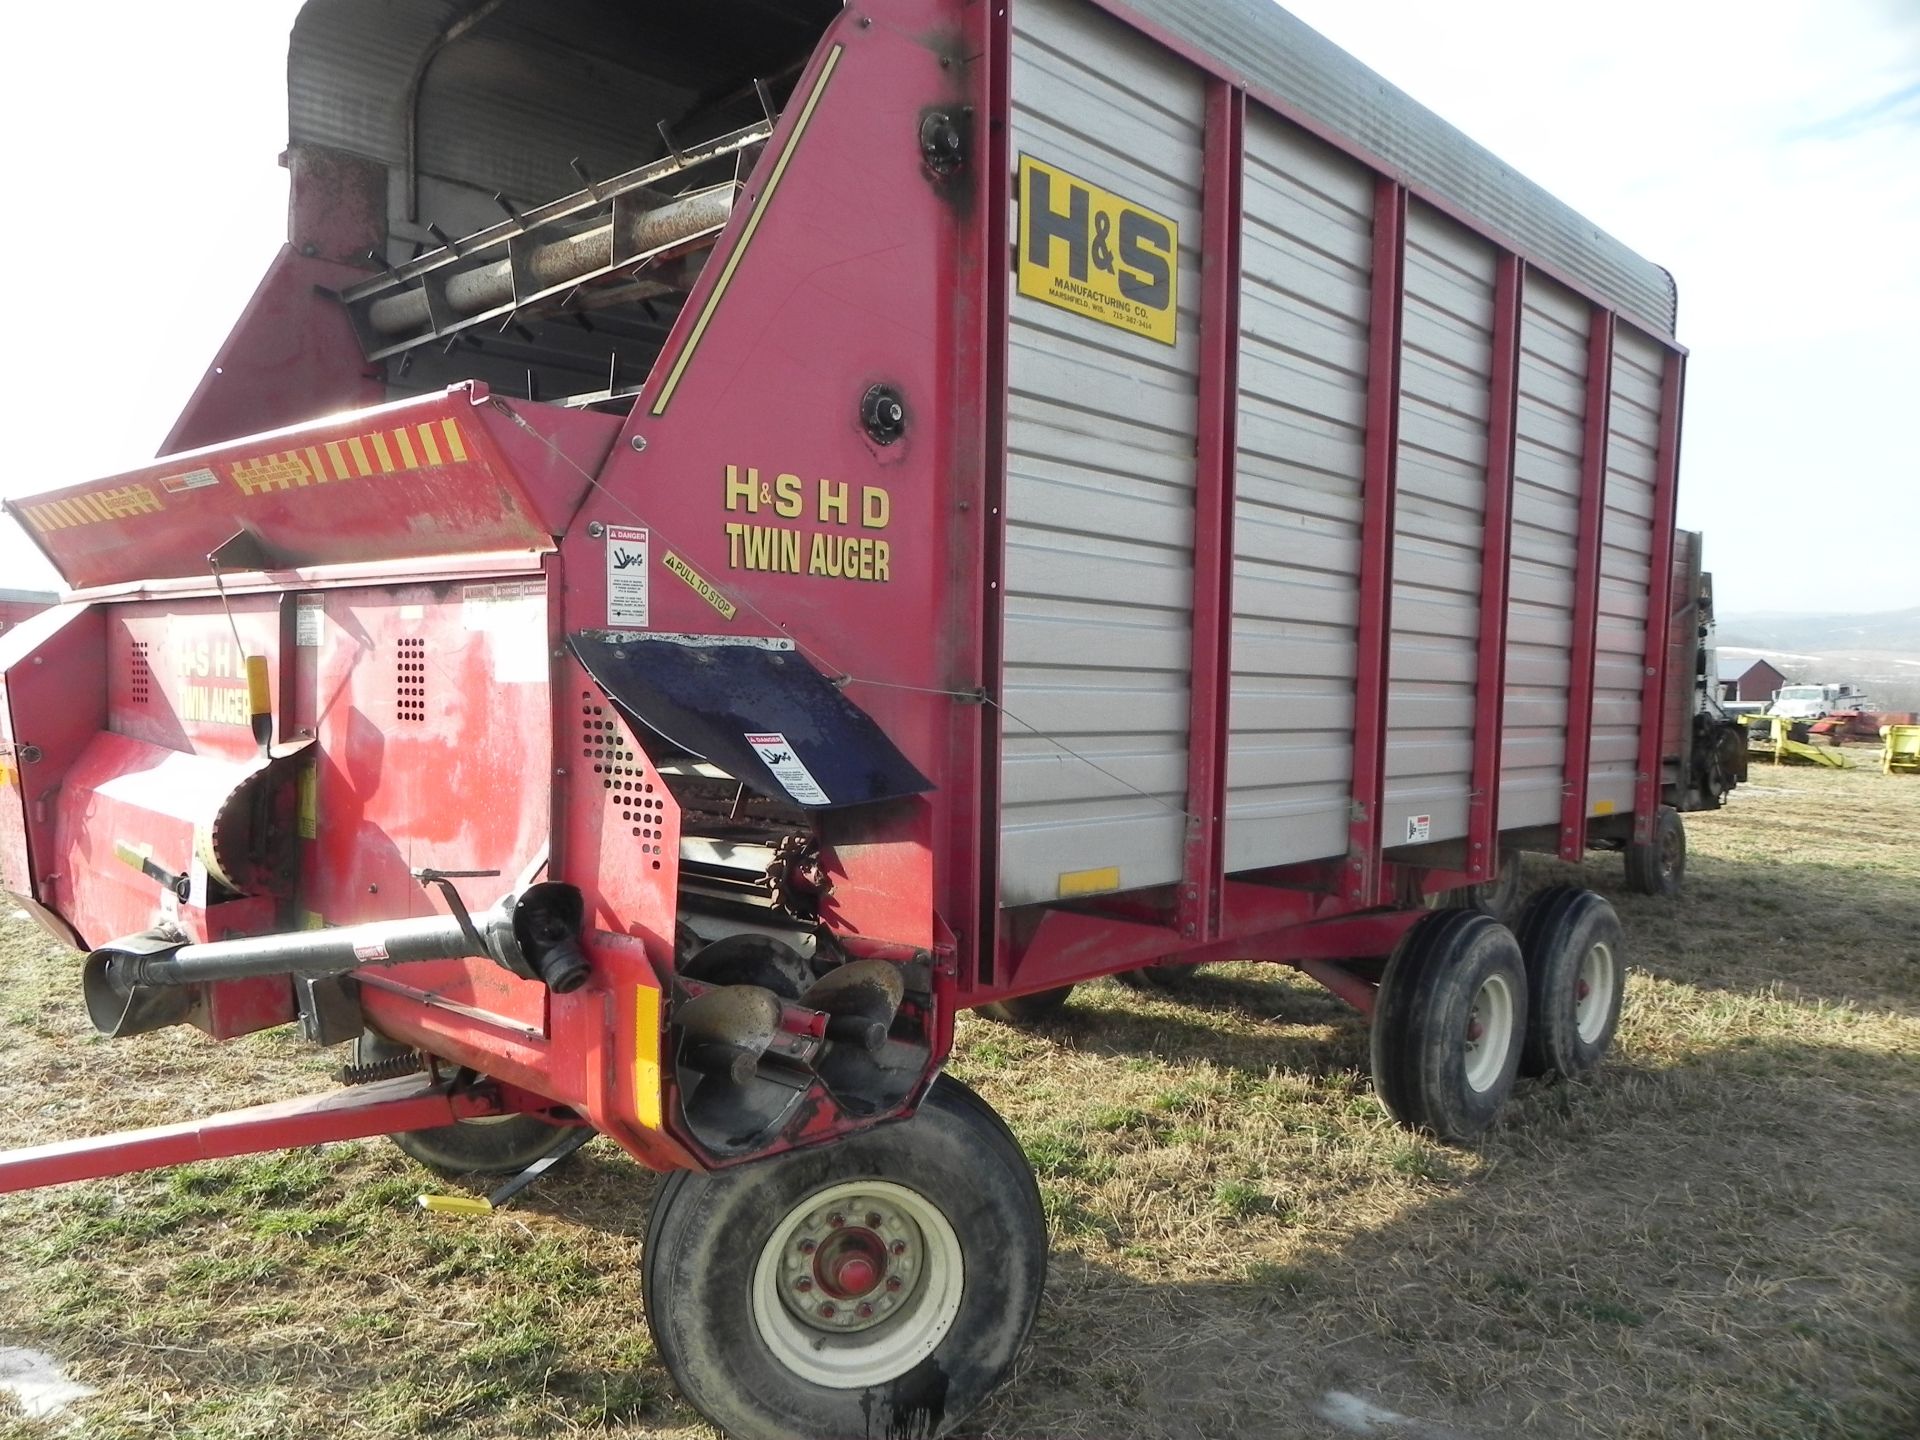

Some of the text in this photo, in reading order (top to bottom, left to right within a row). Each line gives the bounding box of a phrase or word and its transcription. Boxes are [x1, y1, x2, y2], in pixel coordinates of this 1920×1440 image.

[1029, 166, 1171, 312] H&S
[1054, 276, 1149, 319] MANUFACTURING CO.
[726, 464, 803, 518] H&S
[617, 531, 646, 540] DANGER
[726, 522, 890, 582] TWIN AUGER
[675, 561, 731, 613] PULL TO STOP
